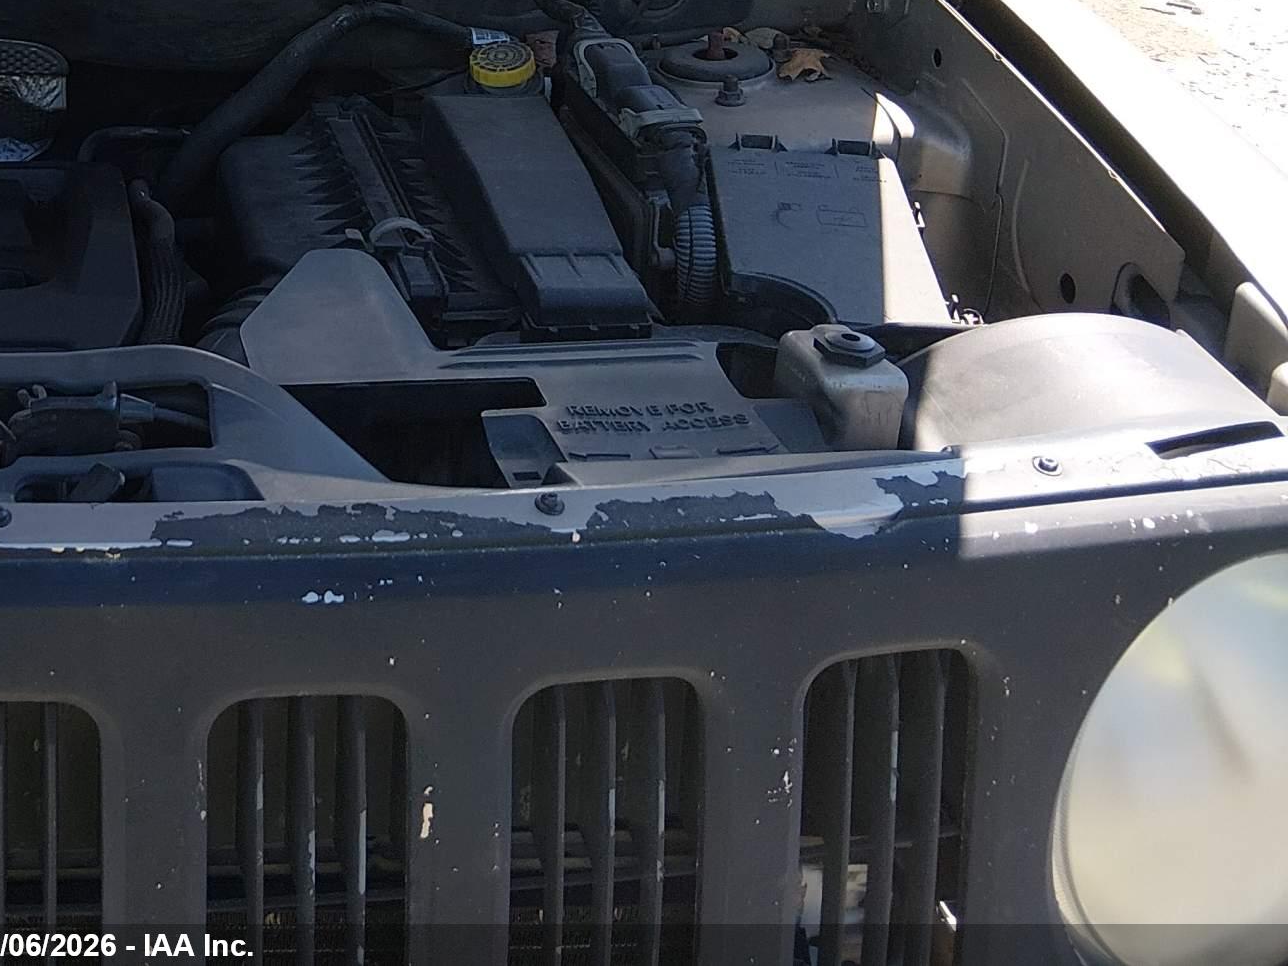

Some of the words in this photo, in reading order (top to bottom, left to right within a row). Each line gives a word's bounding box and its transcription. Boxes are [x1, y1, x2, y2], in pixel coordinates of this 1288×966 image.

[565, 404, 662, 418] REMOVE
[666, 402, 715, 415] FOR
[557, 419, 651, 433] BATTERY
[662, 413, 750, 432] ACCESS
